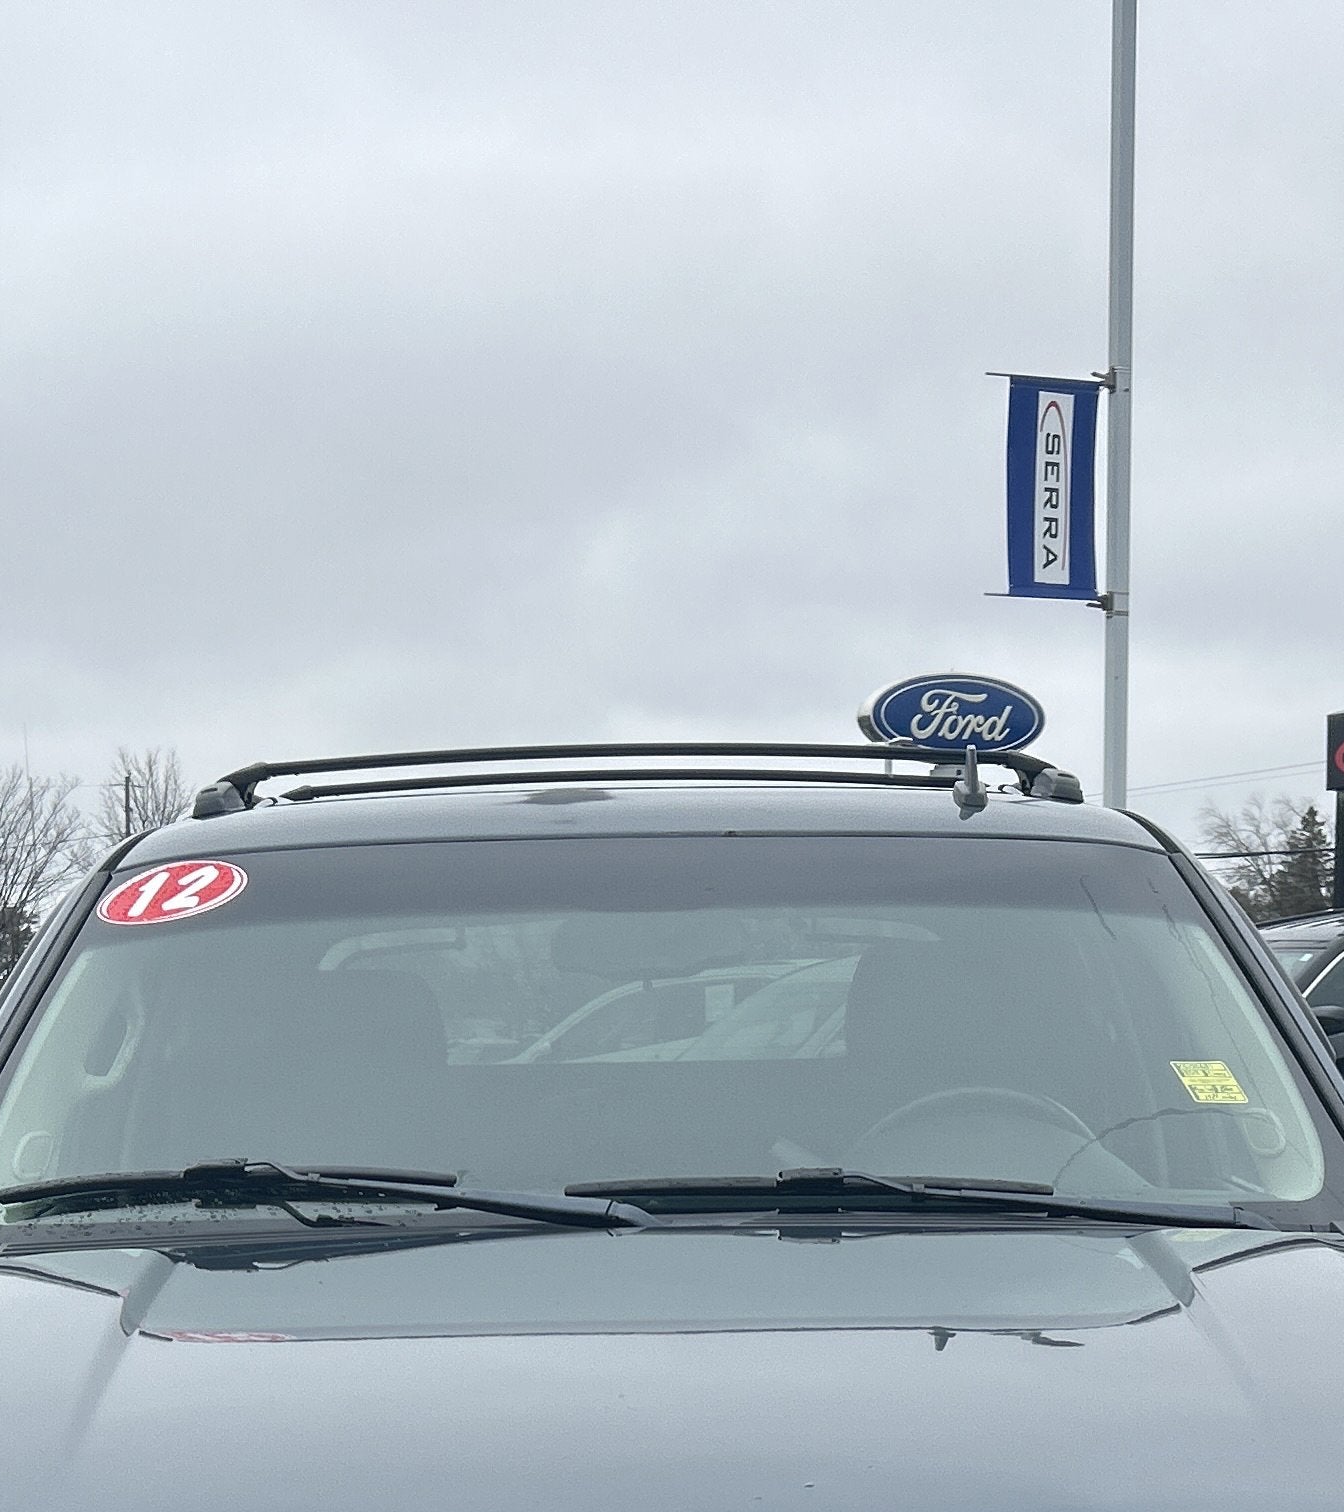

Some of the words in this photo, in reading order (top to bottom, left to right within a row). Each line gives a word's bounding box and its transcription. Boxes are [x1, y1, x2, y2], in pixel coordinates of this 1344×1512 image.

[1042, 431, 1061, 570] SERRA
[910, 688, 1013, 742] Ford
[127, 865, 220, 918] 12
